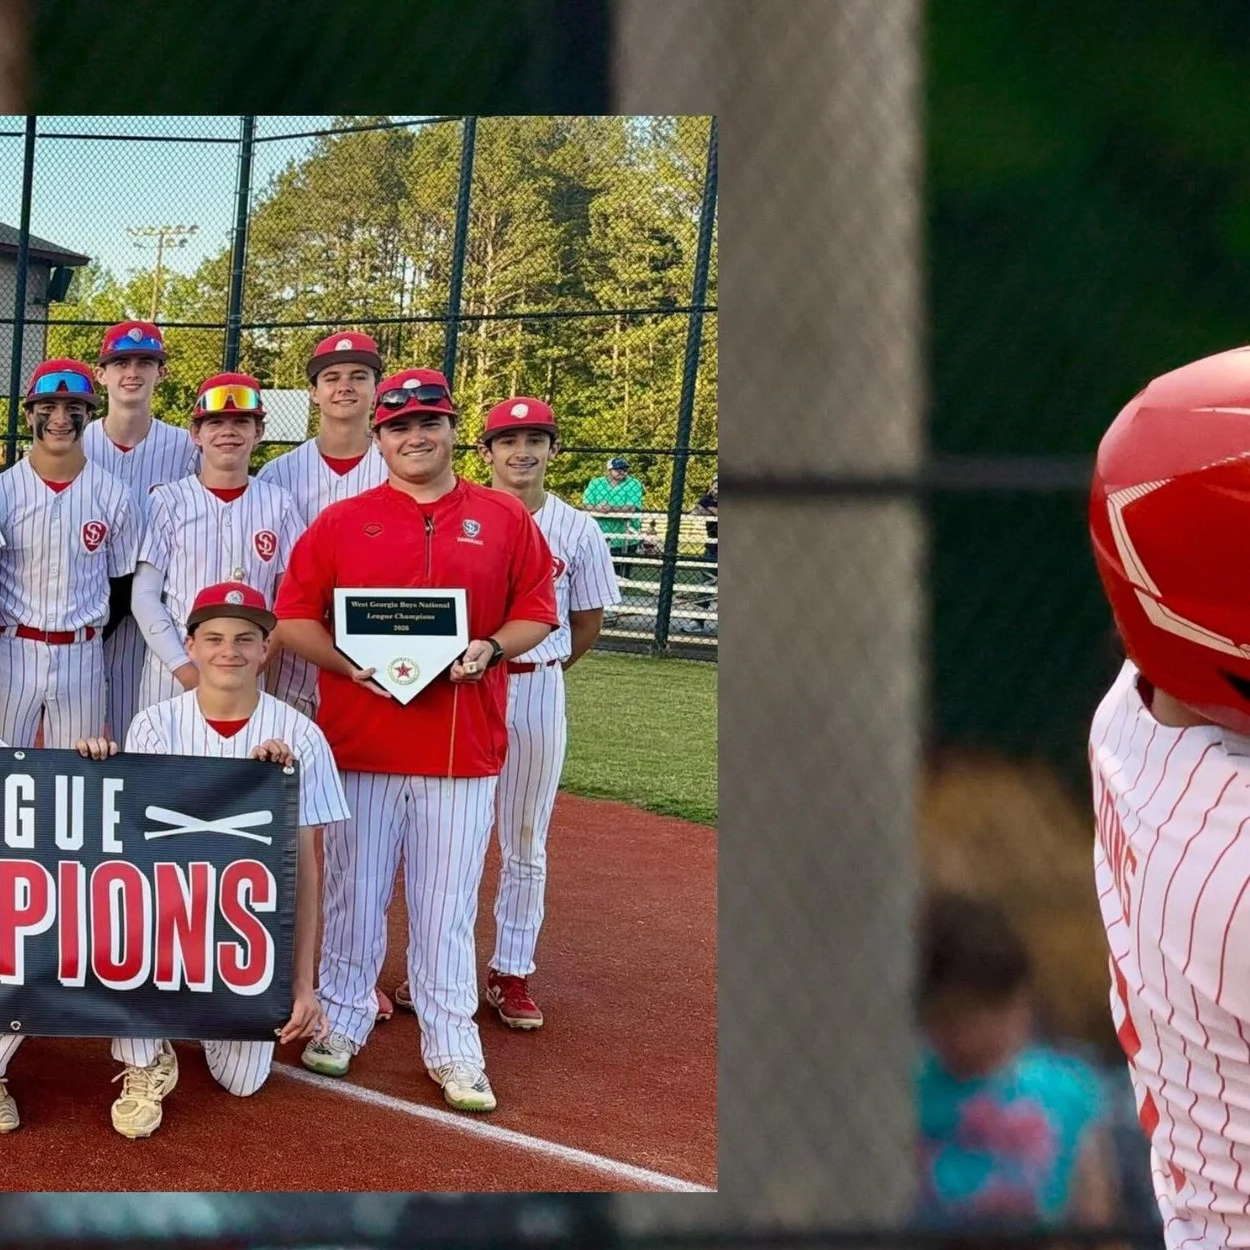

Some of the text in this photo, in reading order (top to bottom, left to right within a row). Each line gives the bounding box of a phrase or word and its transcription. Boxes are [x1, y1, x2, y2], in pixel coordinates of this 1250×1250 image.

[370, 601, 398, 609] Georgia
[367, 612, 435, 621] League Champions
